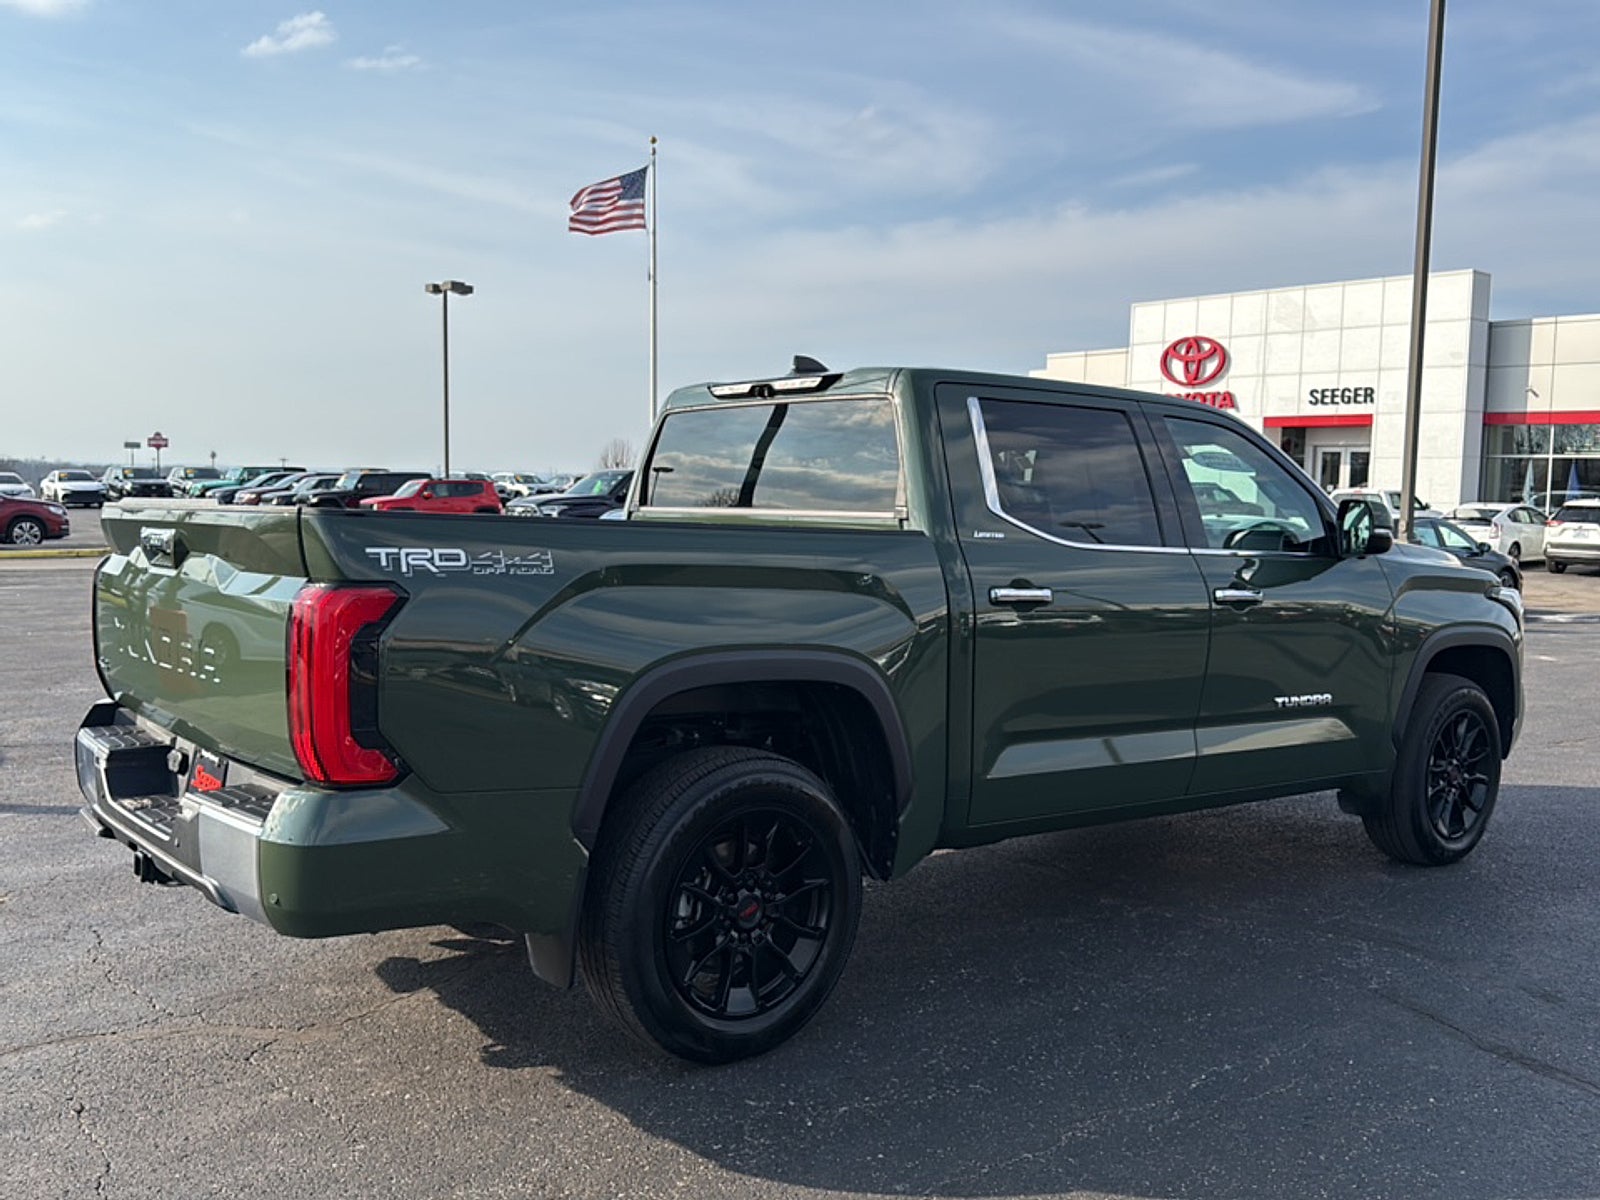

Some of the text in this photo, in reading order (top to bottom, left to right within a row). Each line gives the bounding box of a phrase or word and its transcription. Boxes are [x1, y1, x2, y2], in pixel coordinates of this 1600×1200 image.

[1168, 390, 1236, 410] OTA
[1309, 387, 1374, 405] SEEGER
[365, 547, 471, 577] TRD
[1274, 693, 1332, 707] TUNDRA
